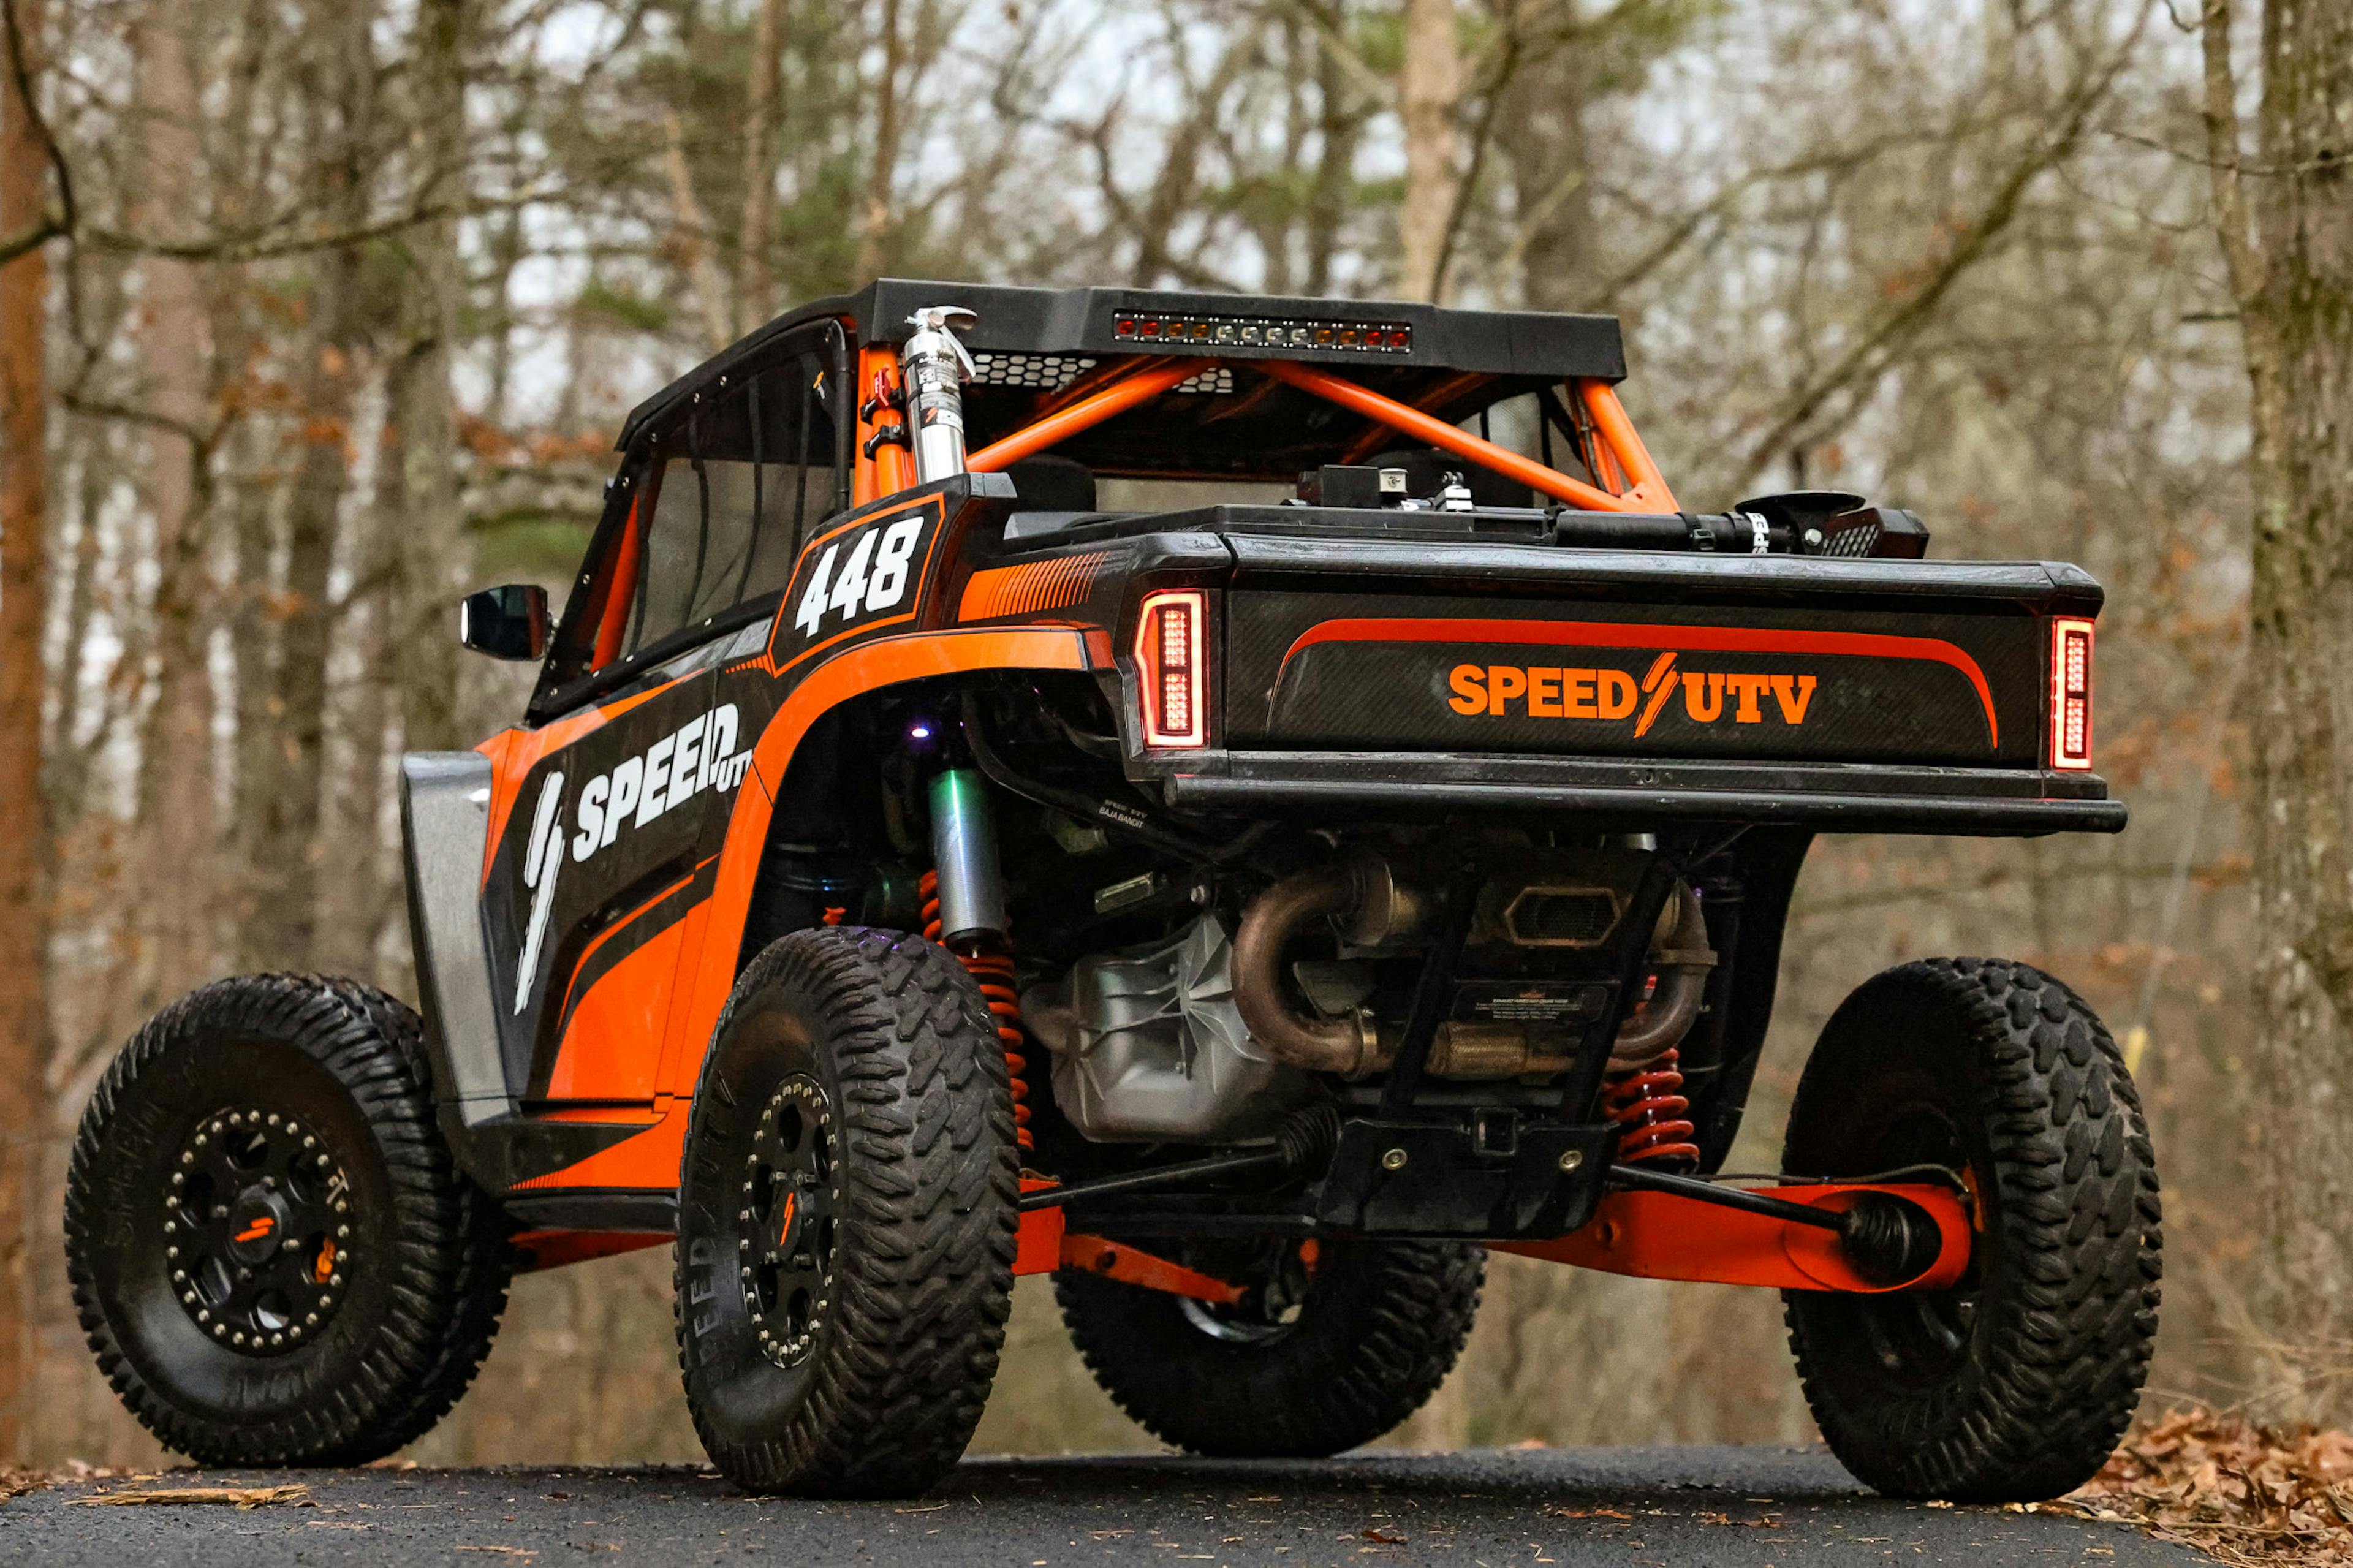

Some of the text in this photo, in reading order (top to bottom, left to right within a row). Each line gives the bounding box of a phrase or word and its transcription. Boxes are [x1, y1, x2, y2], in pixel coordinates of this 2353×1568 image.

[794, 516, 925, 638] 448
[1448, 664, 1817, 725] SPEED UTV
[572, 703, 739, 863] SPEED
